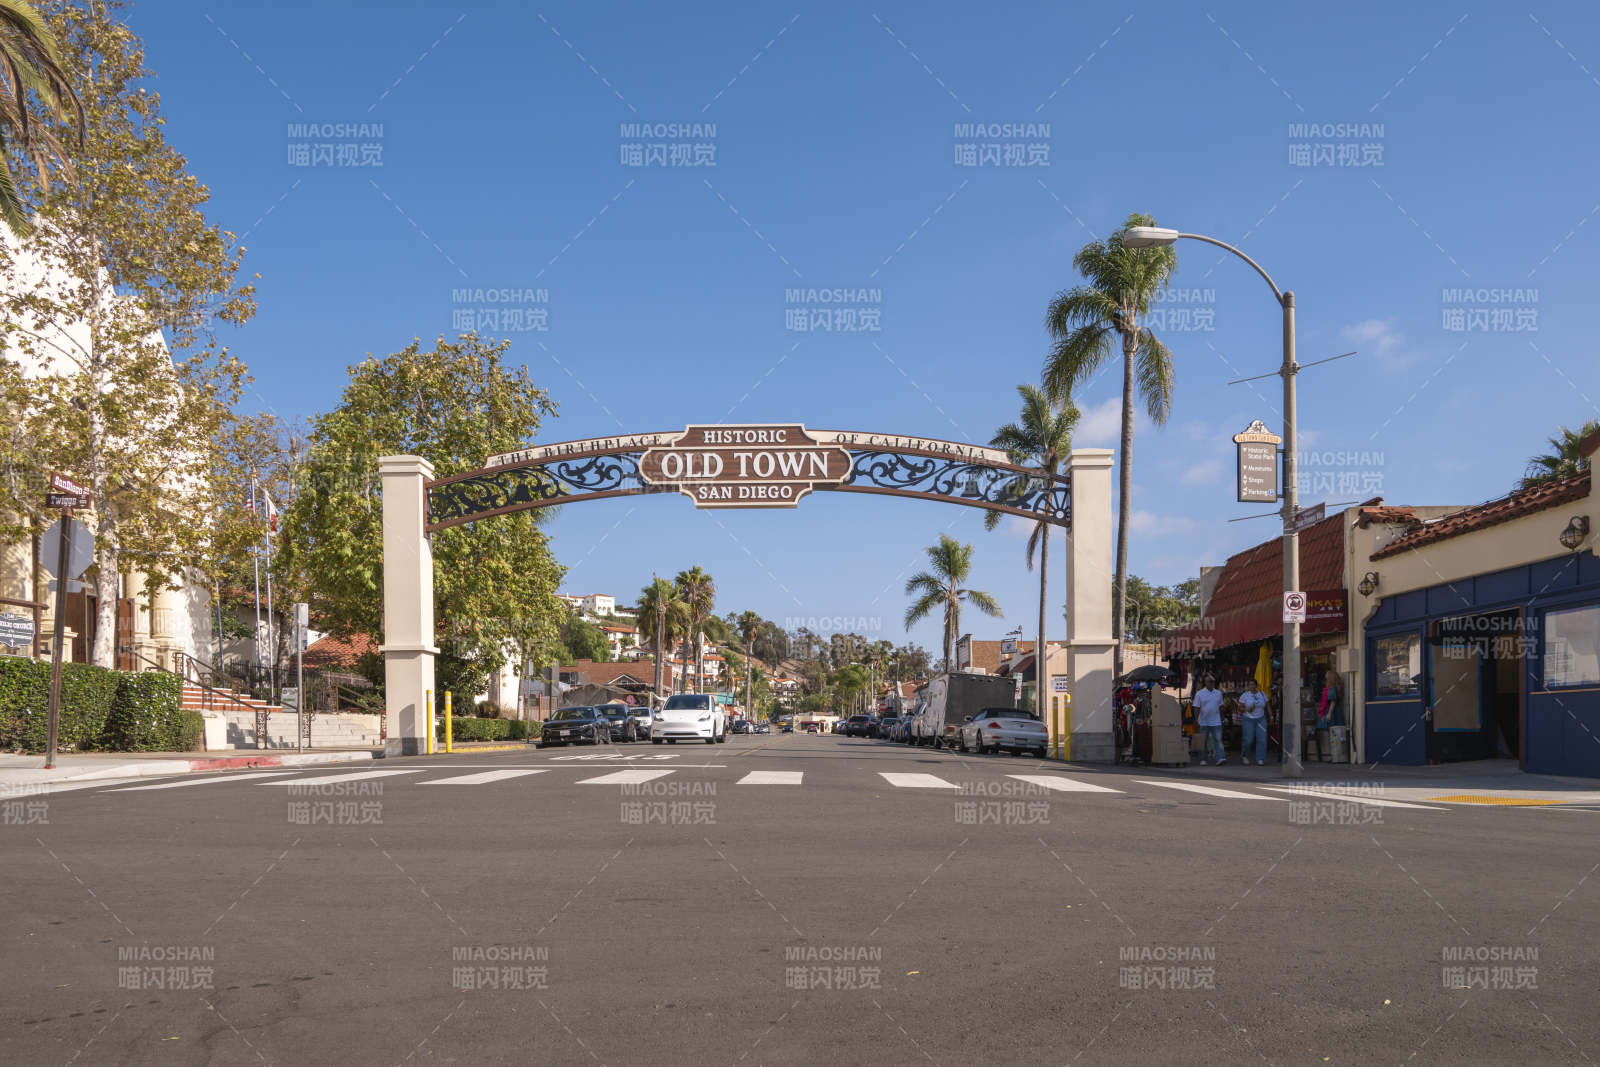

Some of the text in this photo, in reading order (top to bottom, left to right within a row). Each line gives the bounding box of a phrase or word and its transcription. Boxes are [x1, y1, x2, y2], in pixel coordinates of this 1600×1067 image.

[497, 434, 663, 465] THE BIRTHPLACE
[703, 430, 787, 444] HISTORIC
[836, 433, 986, 459] OF CALIFORNIA
[661, 452, 724, 478] OLD
[733, 451, 829, 478] TOWN
[699, 485, 793, 499] SAN DIEGO
